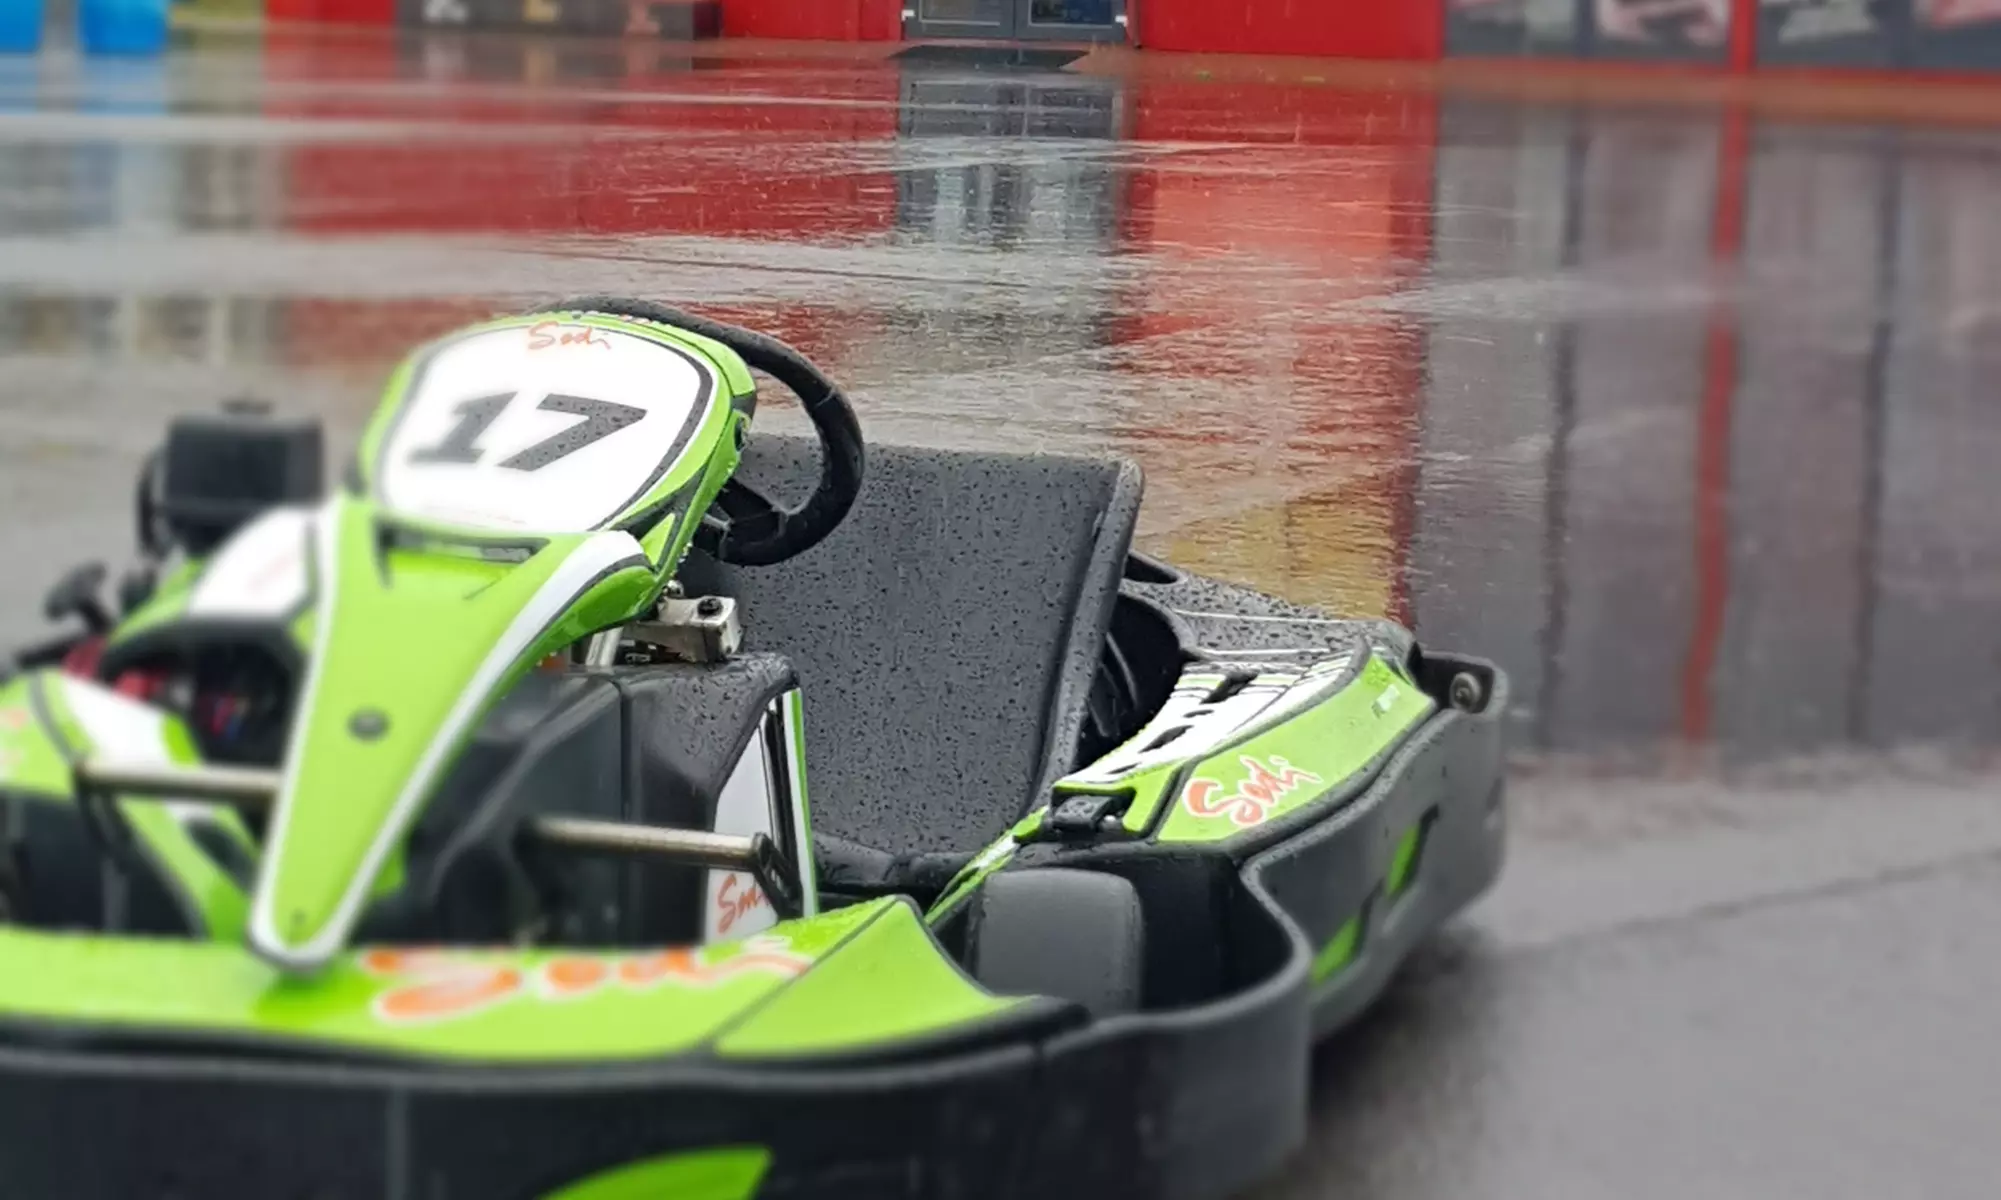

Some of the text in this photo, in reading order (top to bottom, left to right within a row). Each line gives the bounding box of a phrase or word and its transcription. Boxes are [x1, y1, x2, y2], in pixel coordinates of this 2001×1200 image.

[528, 320, 612, 350] Sodi
[404, 391, 648, 472] 17
[1182, 755, 1324, 828] Sodi
